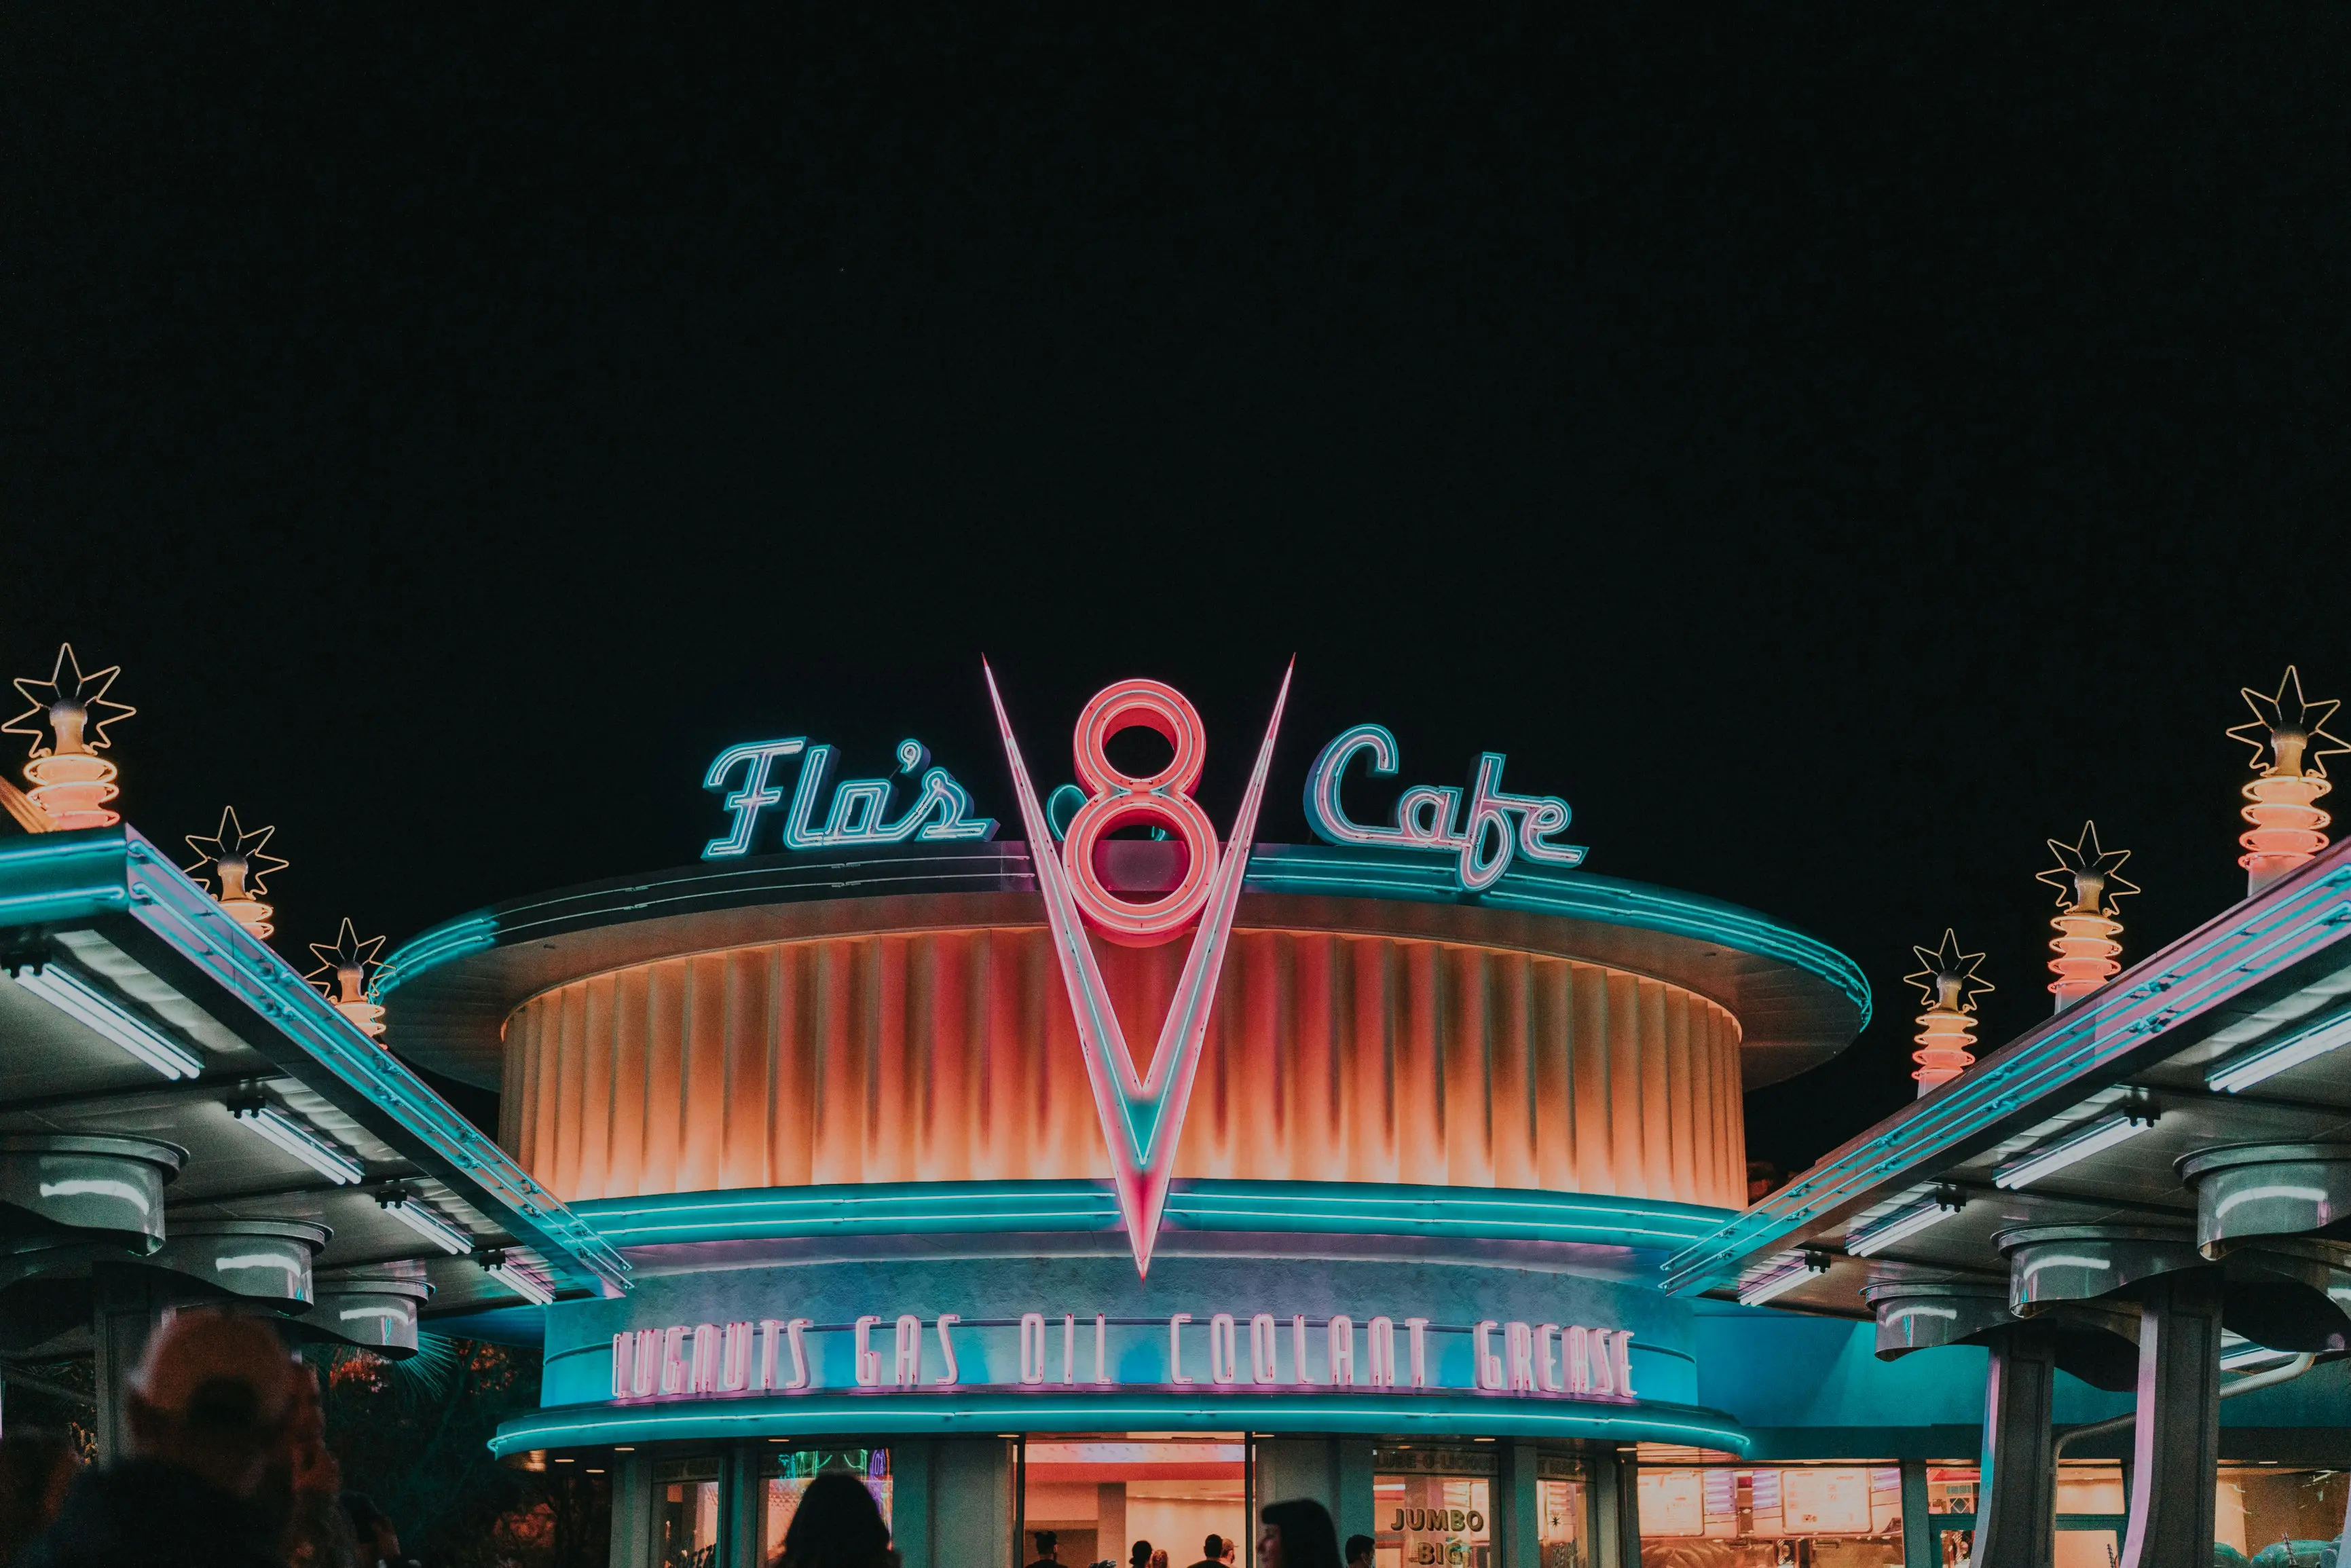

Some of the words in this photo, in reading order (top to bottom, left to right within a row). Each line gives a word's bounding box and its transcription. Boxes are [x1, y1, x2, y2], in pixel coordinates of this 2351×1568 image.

[701, 736, 1000, 862] Flo's
[1303, 724, 1589, 892] Cafe
[612, 1318, 813, 1398] LUGNUTS
[855, 1314, 961, 1387] GAS
[1020, 1313, 1113, 1385] OIL
[1170, 1313, 1429, 1388] COOLANT
[1473, 1320, 1637, 1398] GREASE
[1391, 1508, 1484, 1532] JUMBO
[1418, 1542, 1464, 1565] BIG
